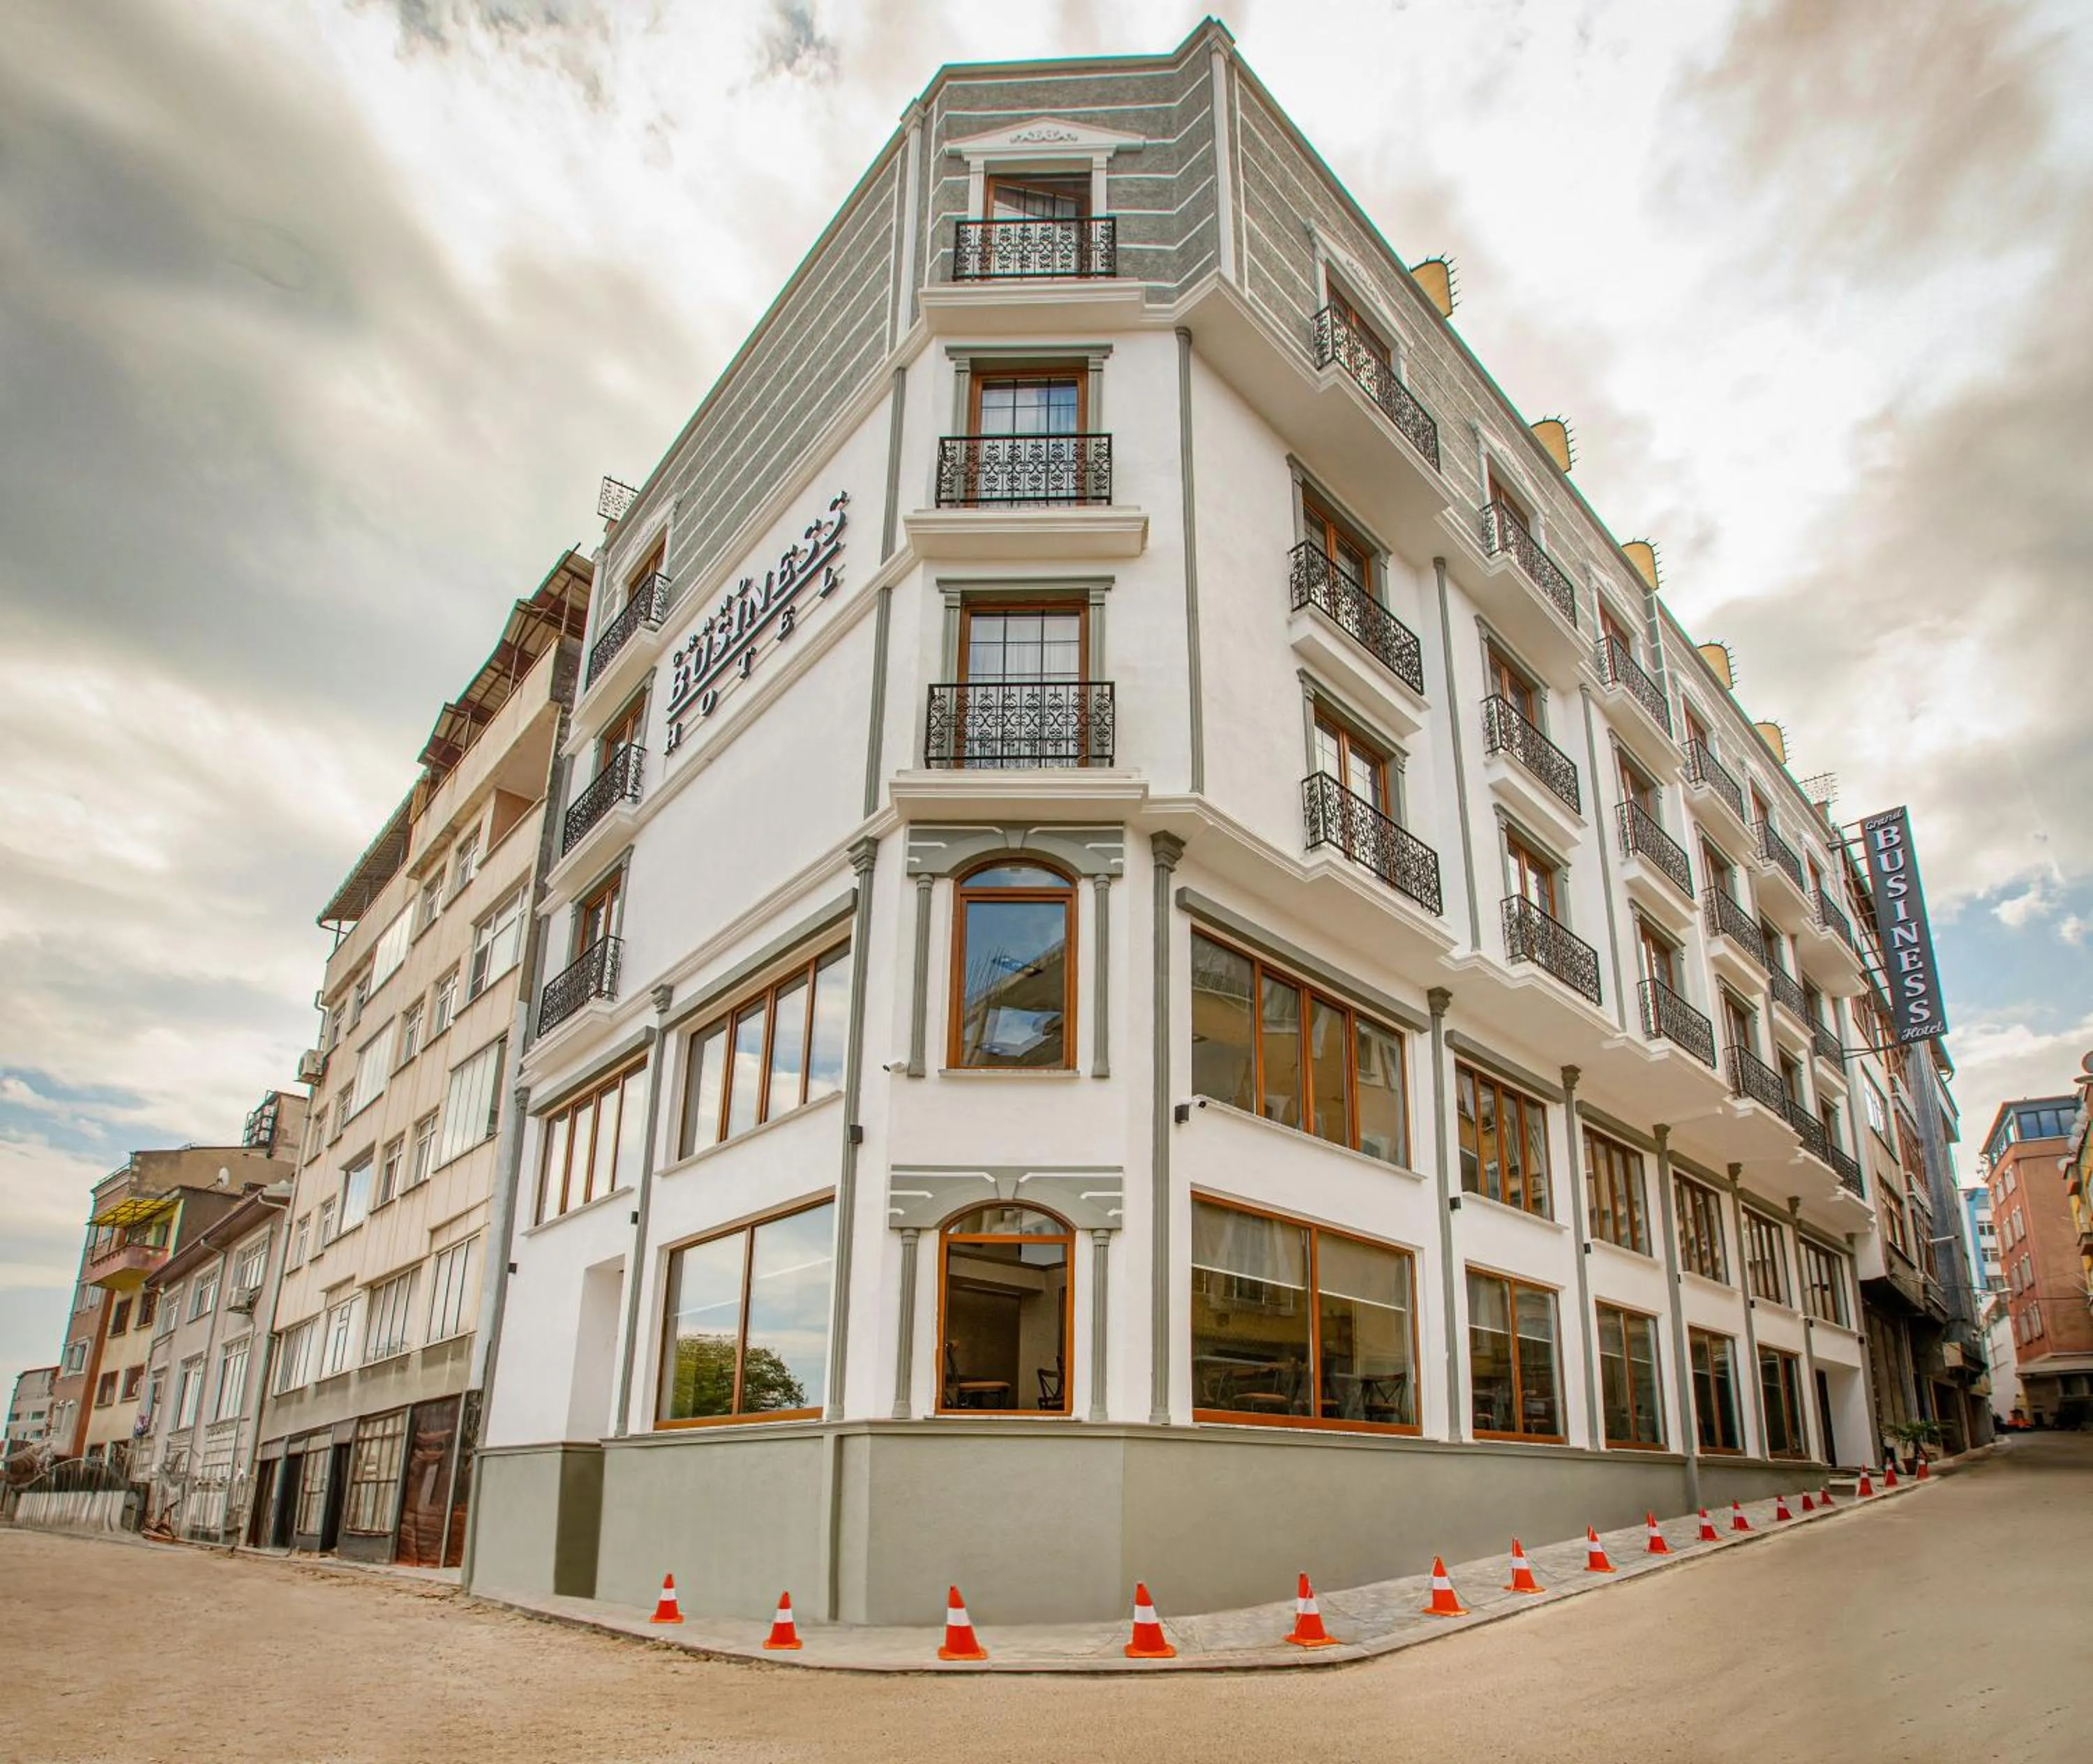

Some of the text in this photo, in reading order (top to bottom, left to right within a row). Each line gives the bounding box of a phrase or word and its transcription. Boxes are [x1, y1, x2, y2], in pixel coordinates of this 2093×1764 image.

[664, 566, 839, 756] HOTEL
[667, 490, 850, 712] BUSINESS
[673, 577, 753, 668] GRAND
[1865, 808, 1904, 830] Grand
[1873, 825, 1931, 1024] BUSINESS
[1901, 1021, 1944, 1041] Hotel
